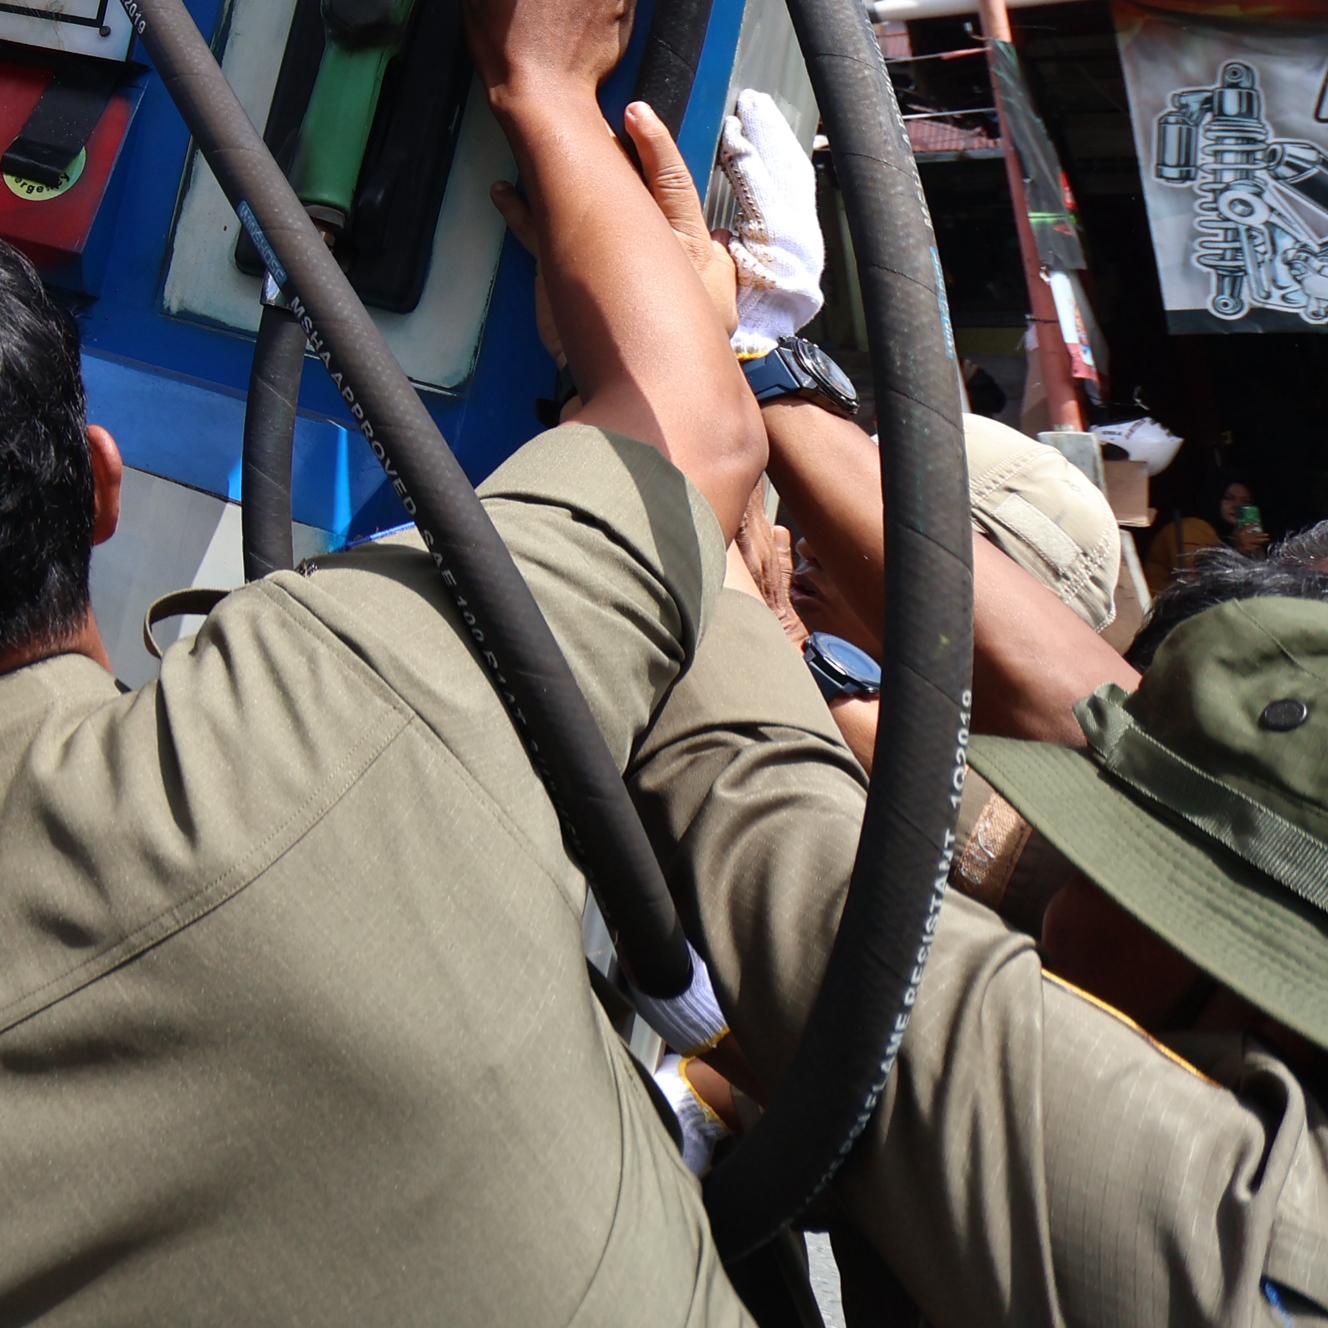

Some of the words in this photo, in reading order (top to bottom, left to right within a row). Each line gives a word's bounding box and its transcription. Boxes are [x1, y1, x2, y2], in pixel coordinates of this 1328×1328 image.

[289, 295, 333, 367] MSHA
[330, 371, 418, 517] APPROVED
[454, 593, 487, 645] 100
[865, 1013, 912, 1112] FLAME
[903, 828, 957, 1008] RESISTANT
